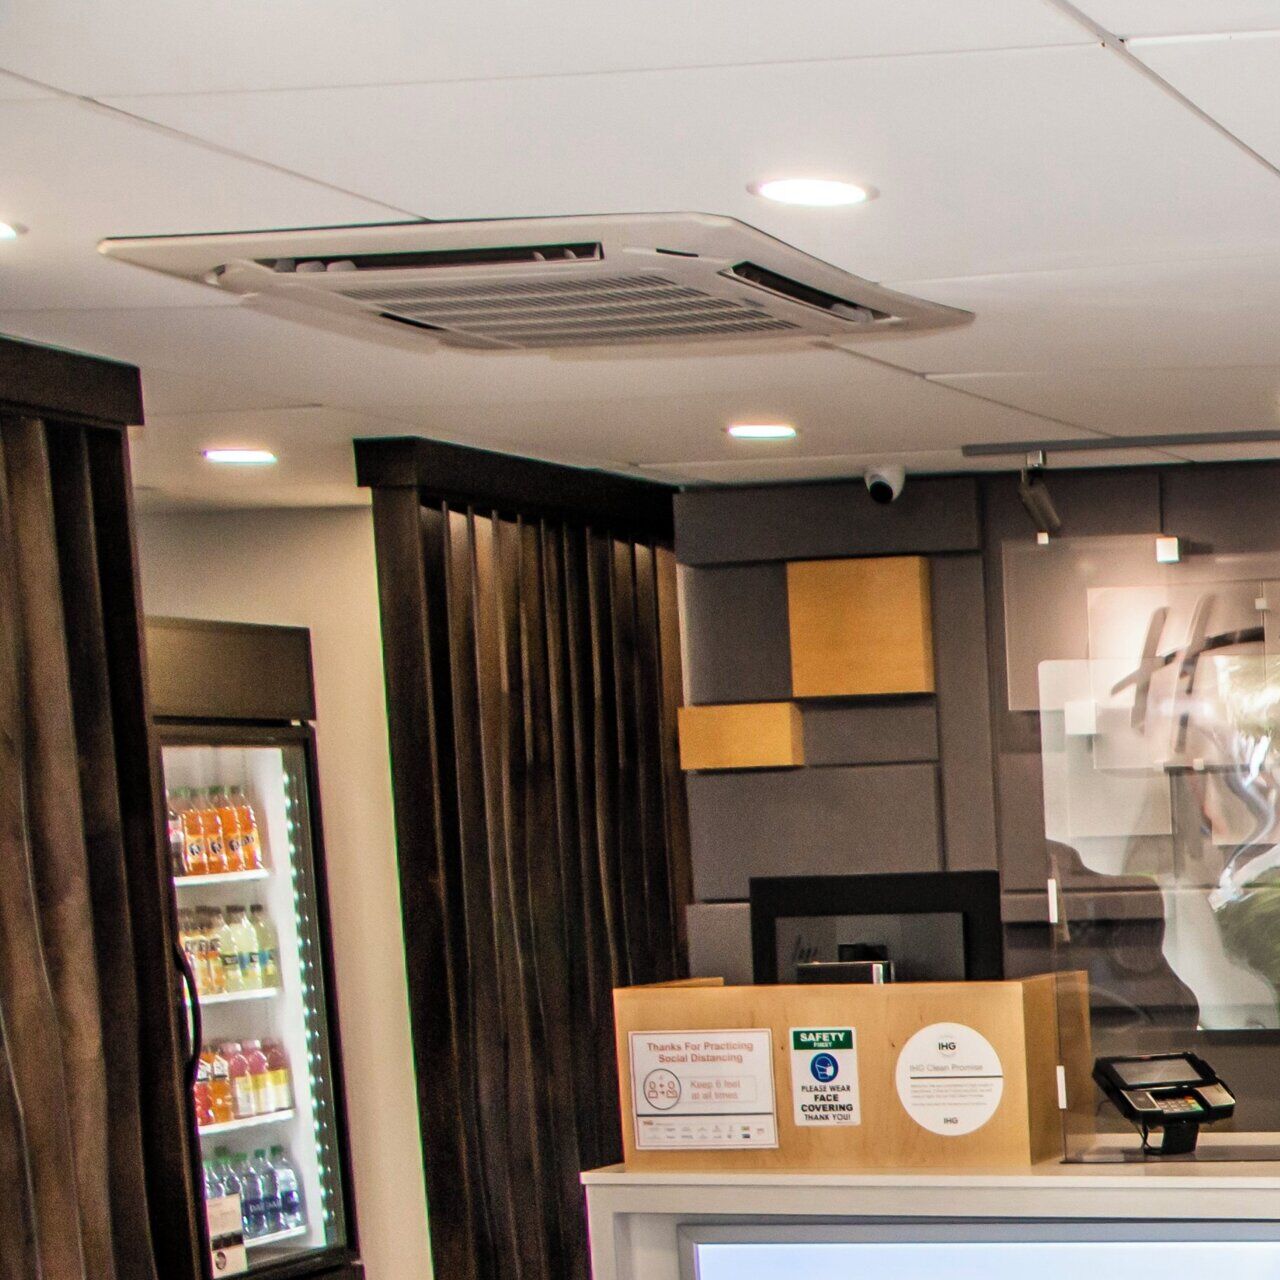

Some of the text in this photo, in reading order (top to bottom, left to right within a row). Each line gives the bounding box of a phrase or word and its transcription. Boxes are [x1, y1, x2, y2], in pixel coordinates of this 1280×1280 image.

[800, 1032, 845, 1042] SAFETY
[647, 1041, 754, 1053] Thanks For Practicing
[938, 1042, 957, 1051] IHG
[658, 1053, 743, 1064] Social Distancing
[910, 1063, 984, 1072] IHG Clean Promise
[801, 1084, 851, 1093] PLEASE WEAR
[814, 1093, 839, 1102] FACE
[801, 1103, 854, 1112] COVERING
[804, 1113, 851, 1121] THANK YOU!
[943, 1117, 959, 1125] IHG
